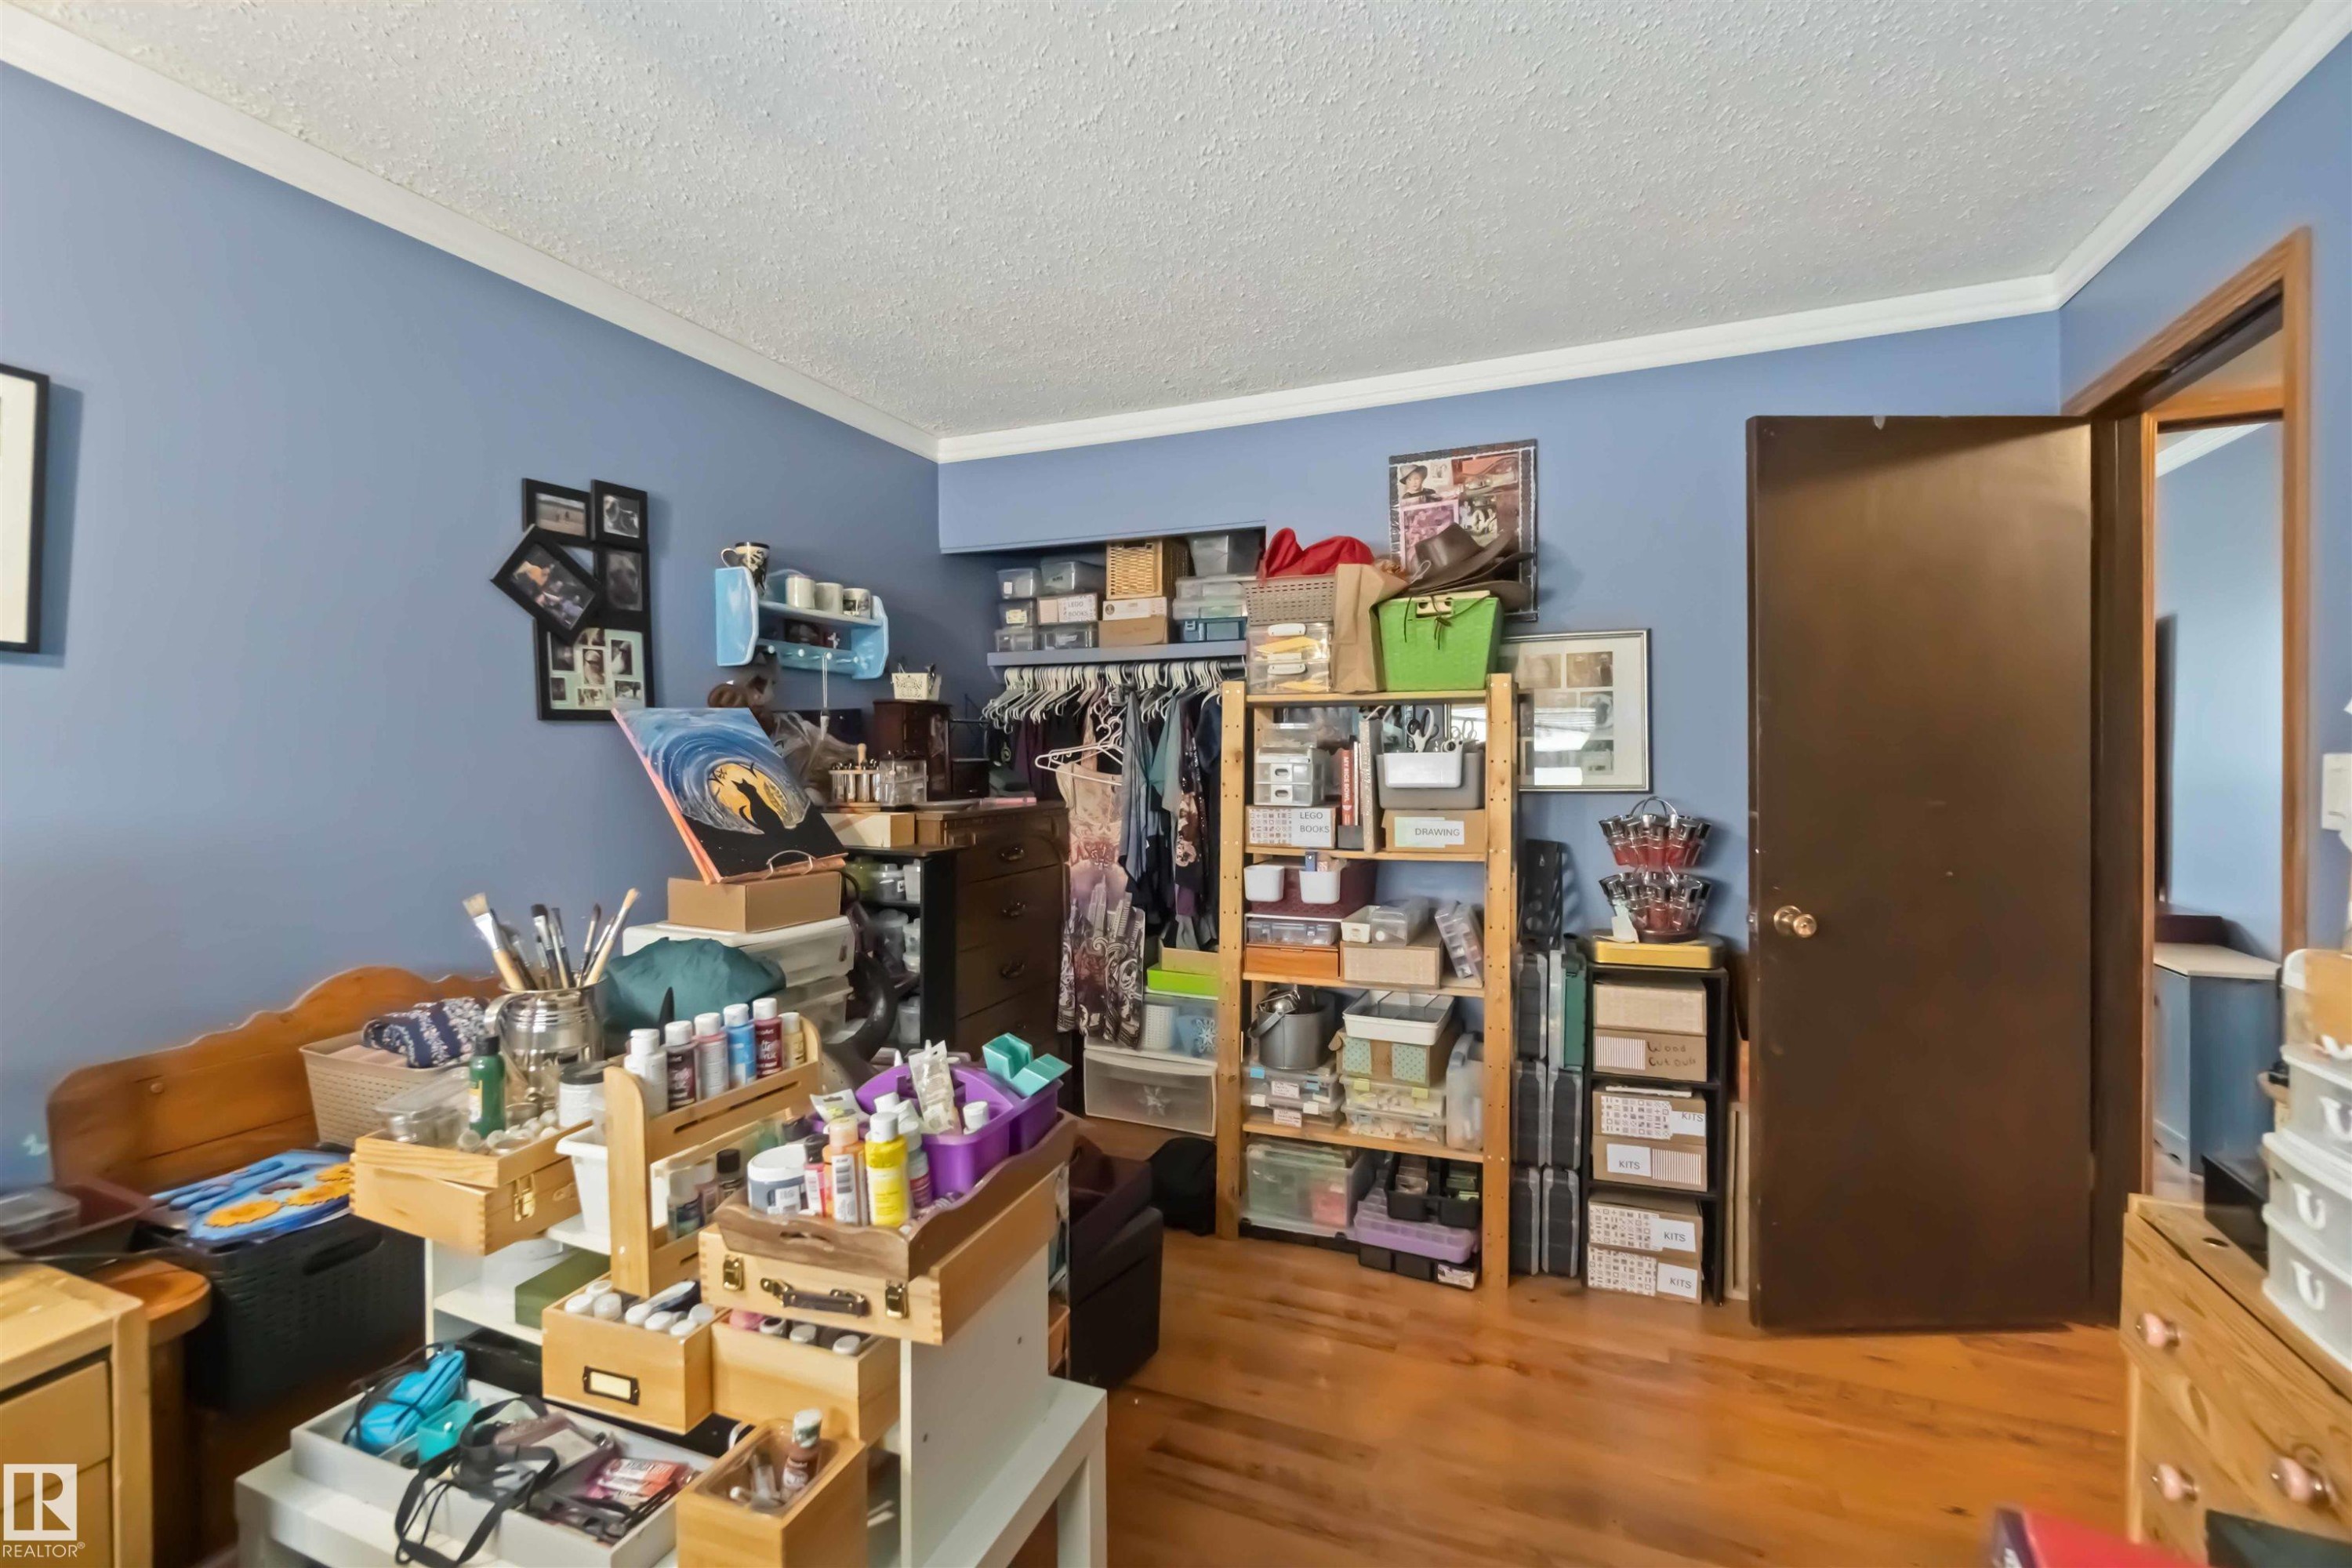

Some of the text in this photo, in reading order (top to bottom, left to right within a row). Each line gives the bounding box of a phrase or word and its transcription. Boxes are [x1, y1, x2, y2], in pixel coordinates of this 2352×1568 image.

[1344, 756, 1350, 768] MY
[1299, 825, 1330, 833] BOOKS
[1414, 828, 1461, 837] DRAWING
[1681, 1111, 1704, 1123] KITS
[1618, 1160, 1640, 1171] KITS
[1664, 1231, 1686, 1243] KITS
[1669, 1277, 1692, 1290] KITS
